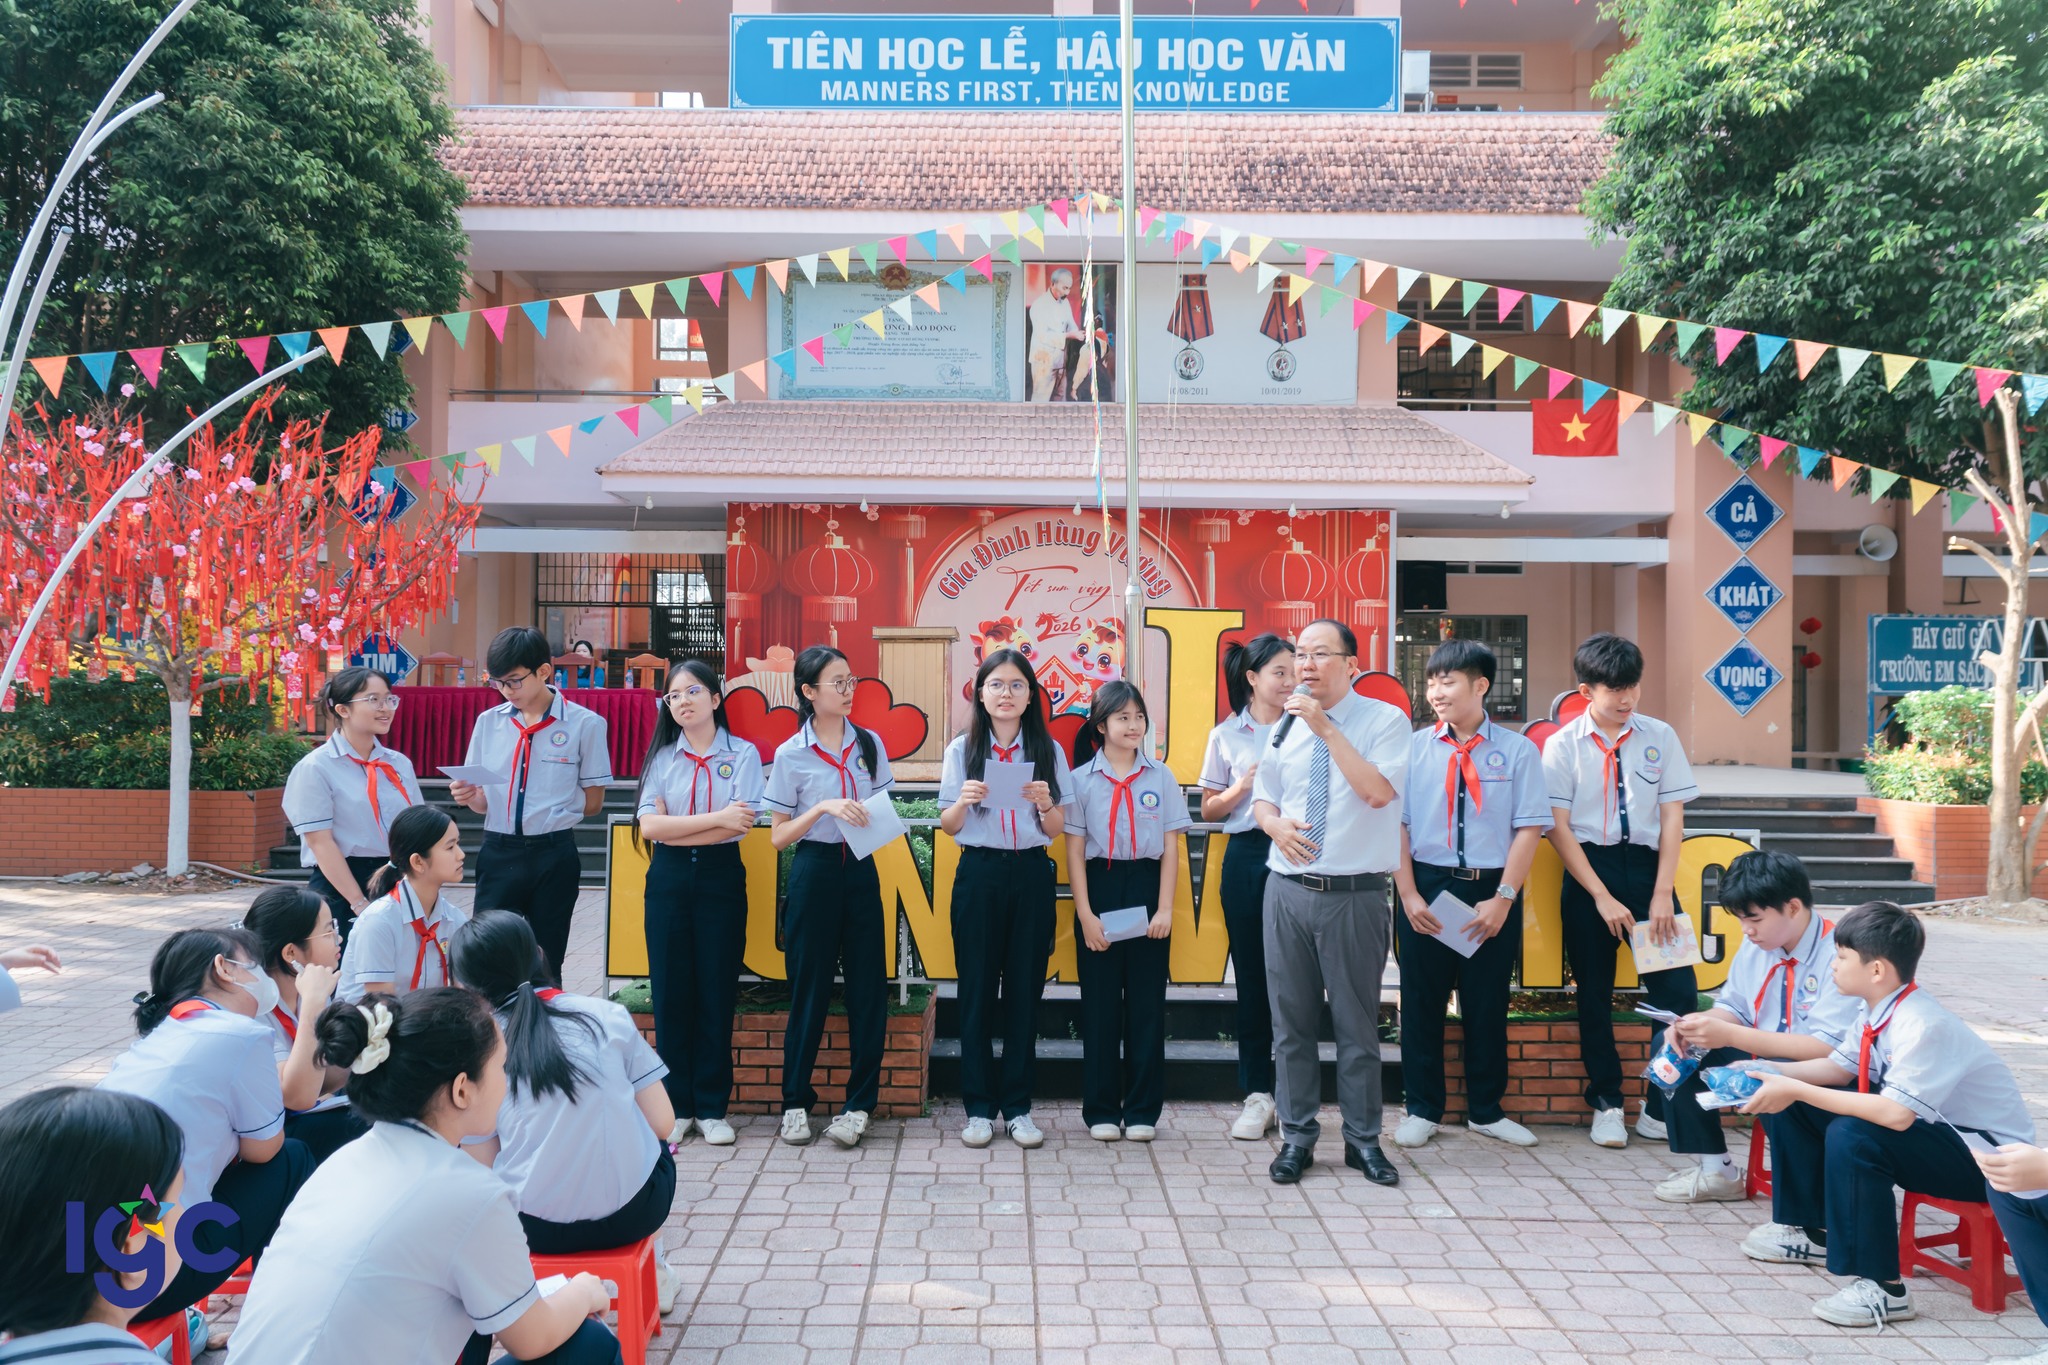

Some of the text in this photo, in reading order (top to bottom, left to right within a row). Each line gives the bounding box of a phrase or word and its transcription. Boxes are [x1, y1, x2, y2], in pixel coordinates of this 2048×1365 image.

[767, 25, 1345, 78] TIÊN HỌC LỄ, HẬU HỌC VĂN
[820, 81, 1290, 105] MANNERS FIRST, THEN KNOWLEDGE
[1730, 495, 1758, 523] CẢ
[938, 560, 978, 599] Gia
[971, 525, 1031, 570] Đình
[1034, 518, 1102, 557] Hùng
[996, 564, 1121, 613] Tết sum vầy
[1719, 581, 1771, 607] KHÁT
[1034, 611, 1082, 643] 2026
[1719, 665, 1767, 691] VỌNG
[1879, 653, 1932, 683] TRƯỜNG
[1934, 660, 1955, 682] EM
